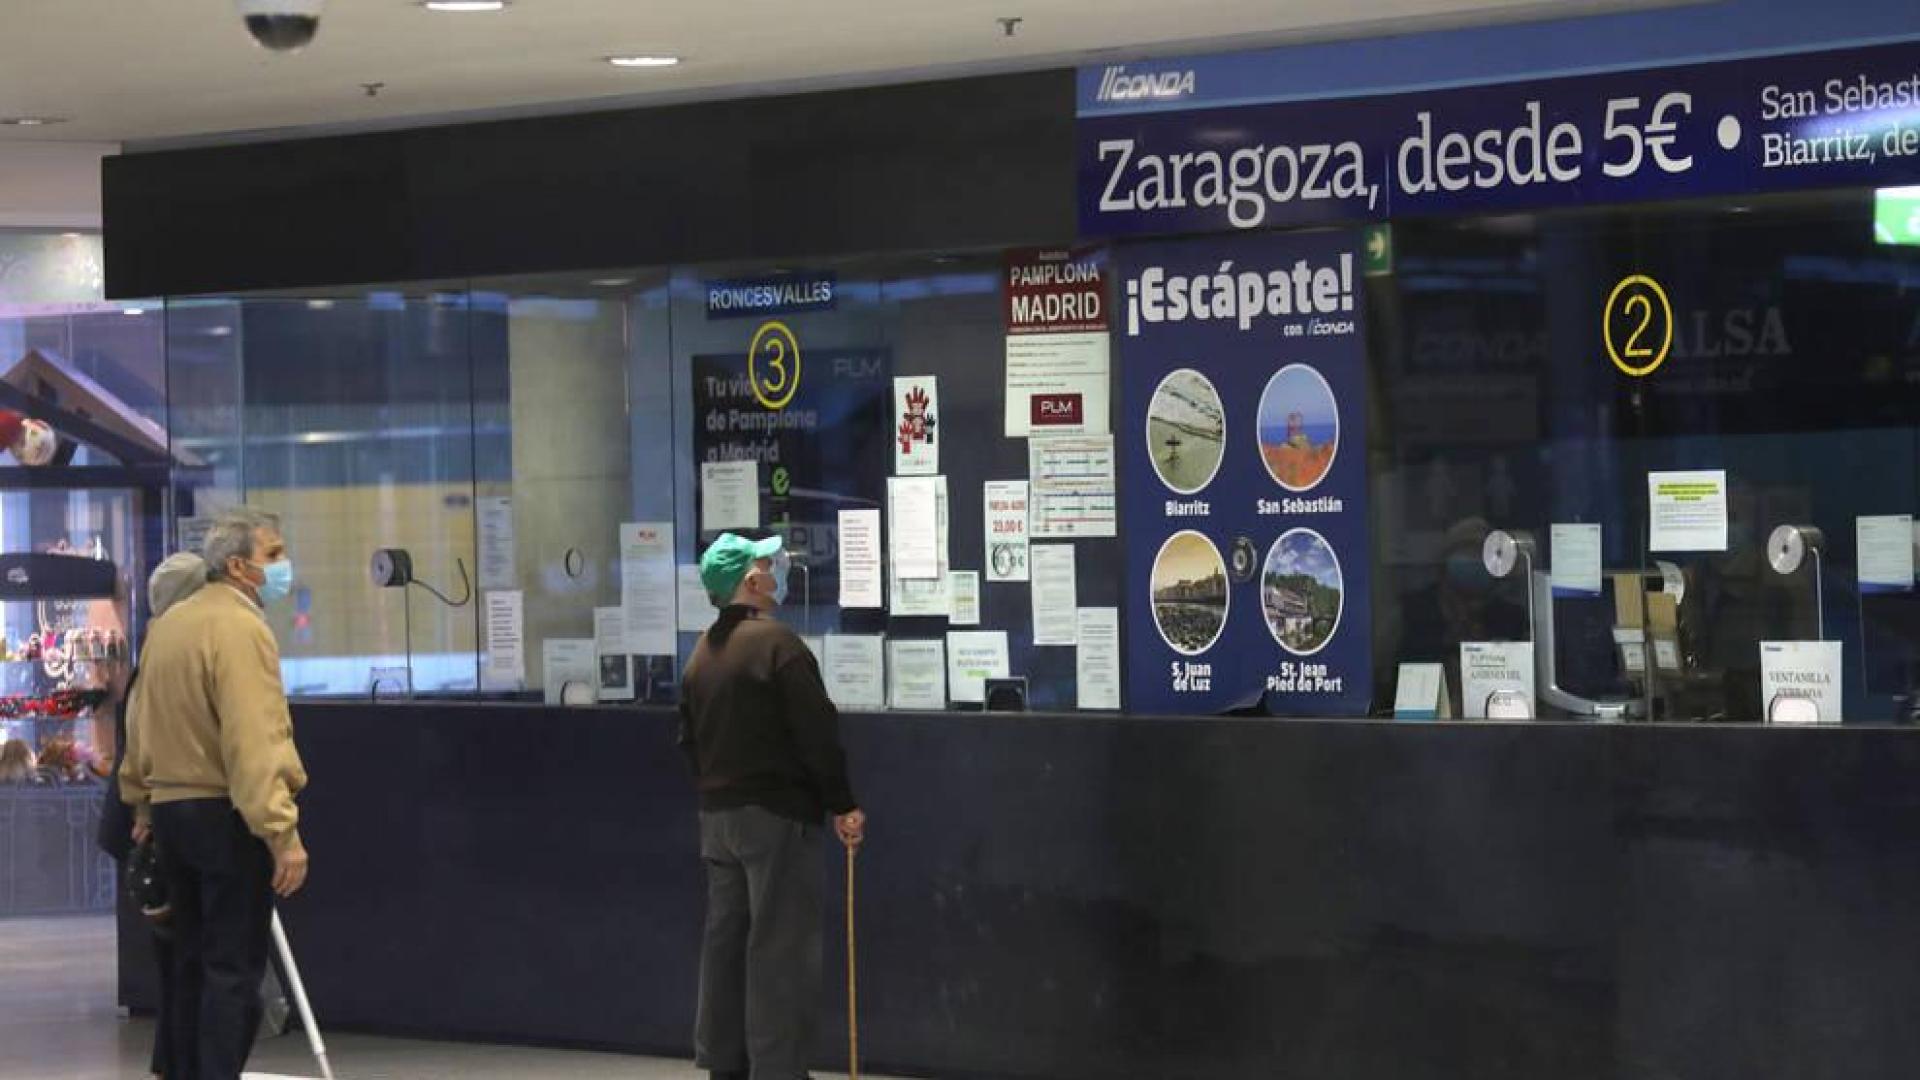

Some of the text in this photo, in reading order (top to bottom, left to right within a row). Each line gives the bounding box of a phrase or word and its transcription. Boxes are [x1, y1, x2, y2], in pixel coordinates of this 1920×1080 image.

[1761, 85, 1817, 120] San
[1099, 92, 1692, 228] Zaragoza, desde 5€
[1761, 129, 1876, 168] Biarritz,
[1010, 263, 1100, 287] PAMPLONA
[709, 281, 831, 310] RONCESVALLES
[1126, 253, 1353, 336] ¡Escápate!
[1011, 292, 1100, 323] MADRID
[1624, 294, 1654, 357] 2
[763, 338, 786, 393] 3
[705, 376, 726, 398] Tu
[1040, 400, 1073, 414] PLM
[706, 408, 817, 436] de Pamplona
[720, 439, 780, 462] Madrid
[1165, 500, 1211, 516] Biarritz
[1256, 496, 1343, 515] San Sebastián
[1184, 662, 1211, 680] Juan
[1281, 662, 1328, 679] St. Jean
[1190, 678, 1211, 691] Luz
[1268, 677, 1342, 692] Pied de Port
